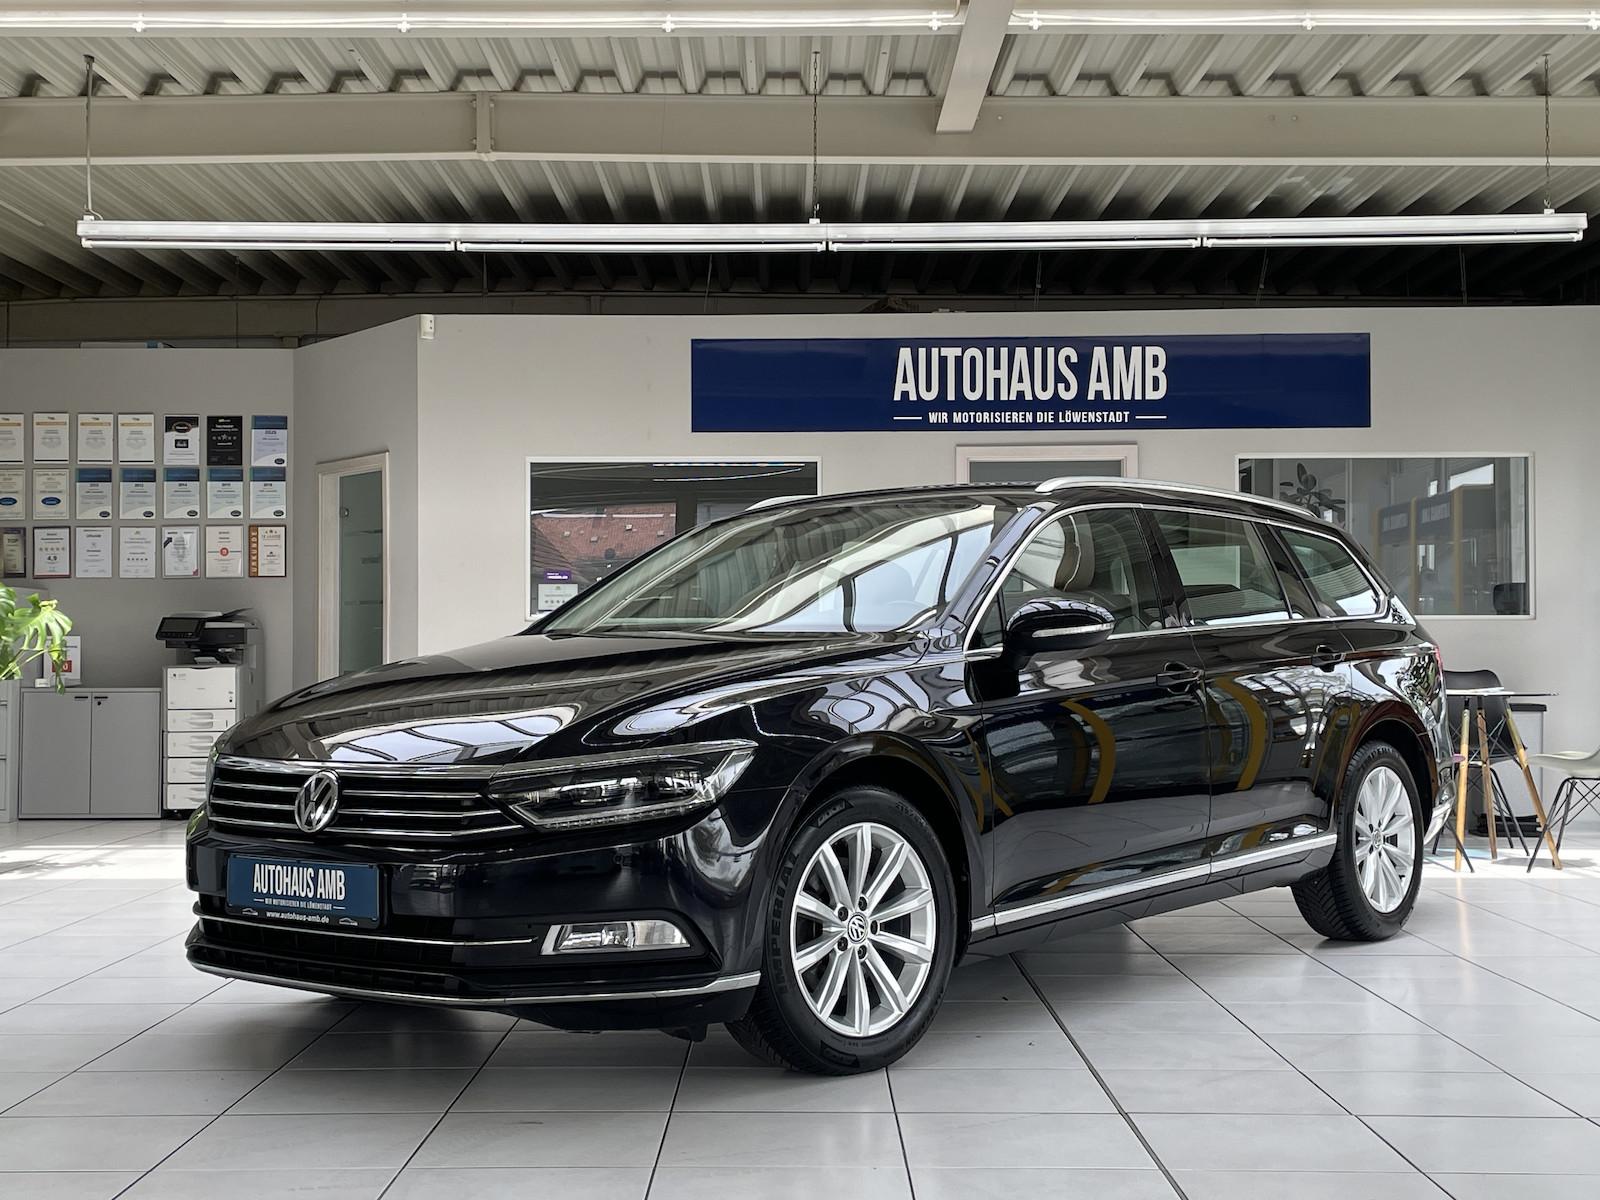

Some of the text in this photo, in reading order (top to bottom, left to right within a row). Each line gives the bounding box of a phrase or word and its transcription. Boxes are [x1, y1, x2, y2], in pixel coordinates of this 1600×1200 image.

[893, 346, 1168, 401] AUTOHAUS AMB
[928, 410, 1130, 423] WIR MOTORISIEREN DIE LÖWENSTADT
[253, 863, 346, 901] AUTOHAUS AMB
[266, 910, 329, 923] www.autohaus-amb.de
